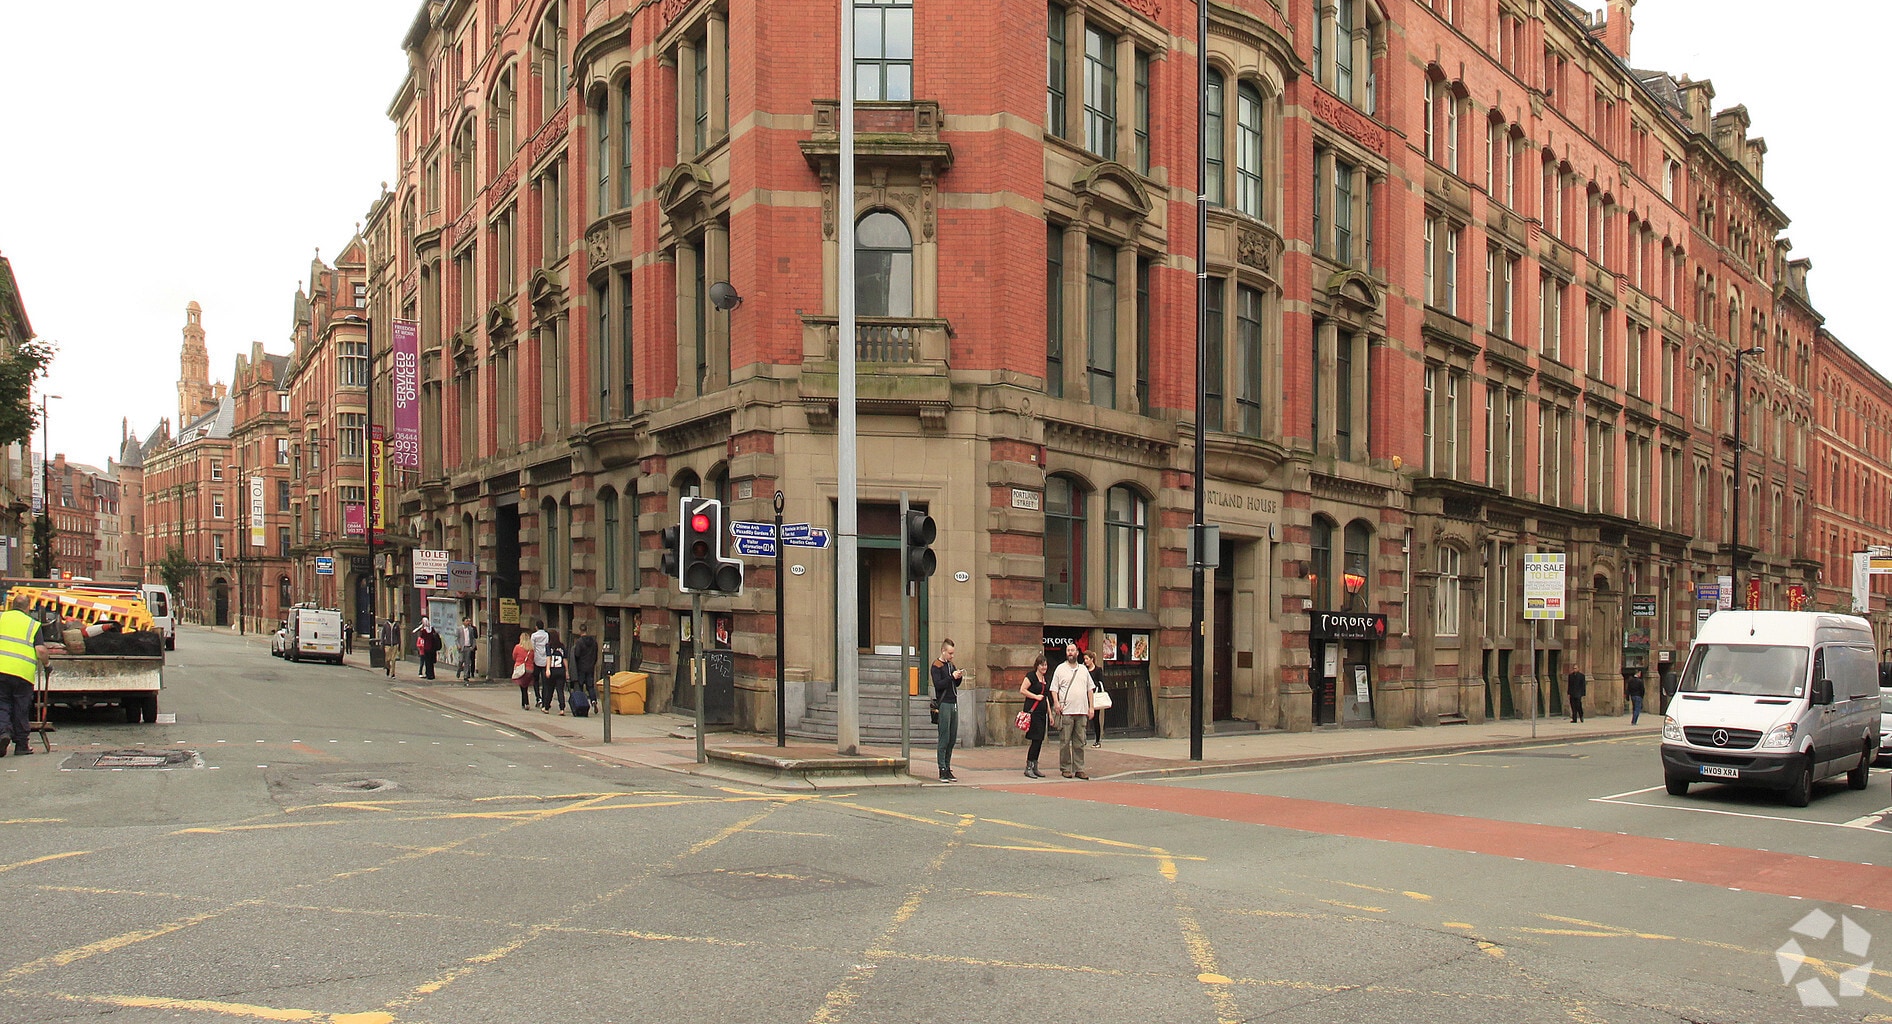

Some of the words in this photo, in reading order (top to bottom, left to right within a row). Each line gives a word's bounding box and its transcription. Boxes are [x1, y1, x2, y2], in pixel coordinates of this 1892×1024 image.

[396, 351, 406, 409] SERVICED
[406, 353, 416, 401] OFFICES
[395, 432, 418, 441] 08444
[395, 440, 418, 454] 993
[395, 451, 418, 466] 373
[253, 481, 262, 497] TO
[1013, 490, 1039, 501] PORTLAND
[1016, 499, 1034, 508] STREET
[1204, 490, 1243, 509] RTLAND
[1247, 496, 1277, 514] HOUSE
[253, 499, 263, 519] LET
[419, 550, 431, 558] TO
[433, 551, 449, 559] LET
[455, 568, 472, 576] mint
[1525, 563, 1542, 572] FOR
[1543, 563, 1564, 572] SALE
[1530, 571, 1542, 579] TO
[1543, 571, 1559, 579] LET
[1042, 637, 1074, 647] ORORE
[551, 655, 562, 668] 12
[1703, 766, 1722, 775] HV09
[1723, 768, 1737, 777] XRA
